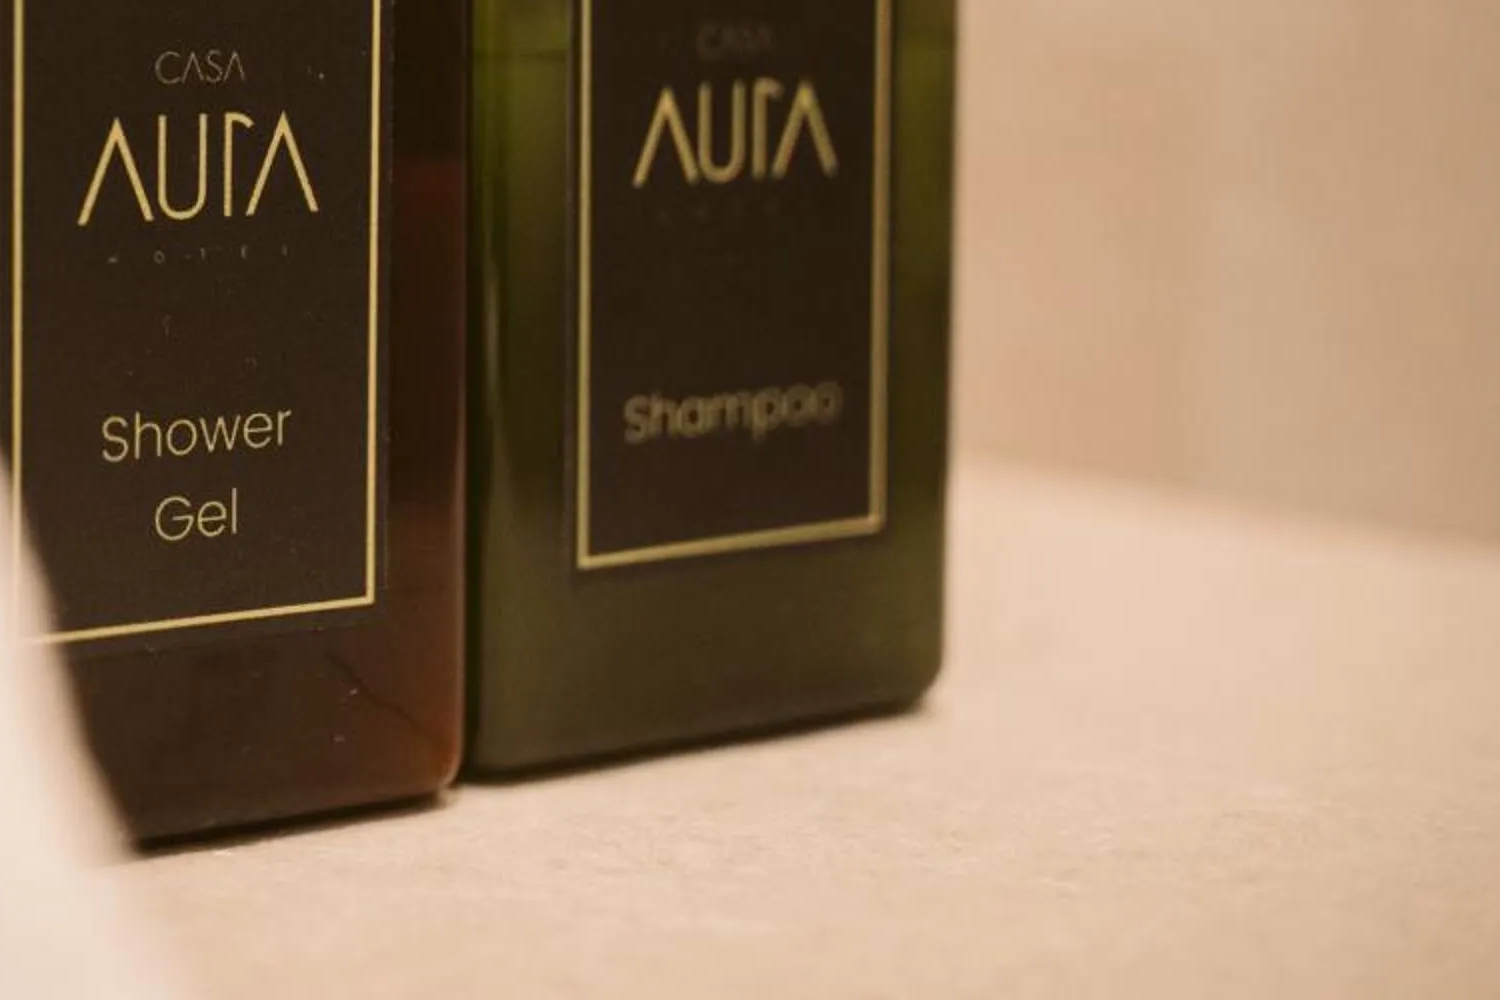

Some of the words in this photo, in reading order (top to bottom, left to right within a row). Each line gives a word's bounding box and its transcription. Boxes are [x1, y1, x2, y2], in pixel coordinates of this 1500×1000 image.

[154, 49, 246, 85] CASA
[100, 408, 292, 463] Shower
[622, 380, 844, 444] Shampoo
[154, 487, 238, 541] Gel
